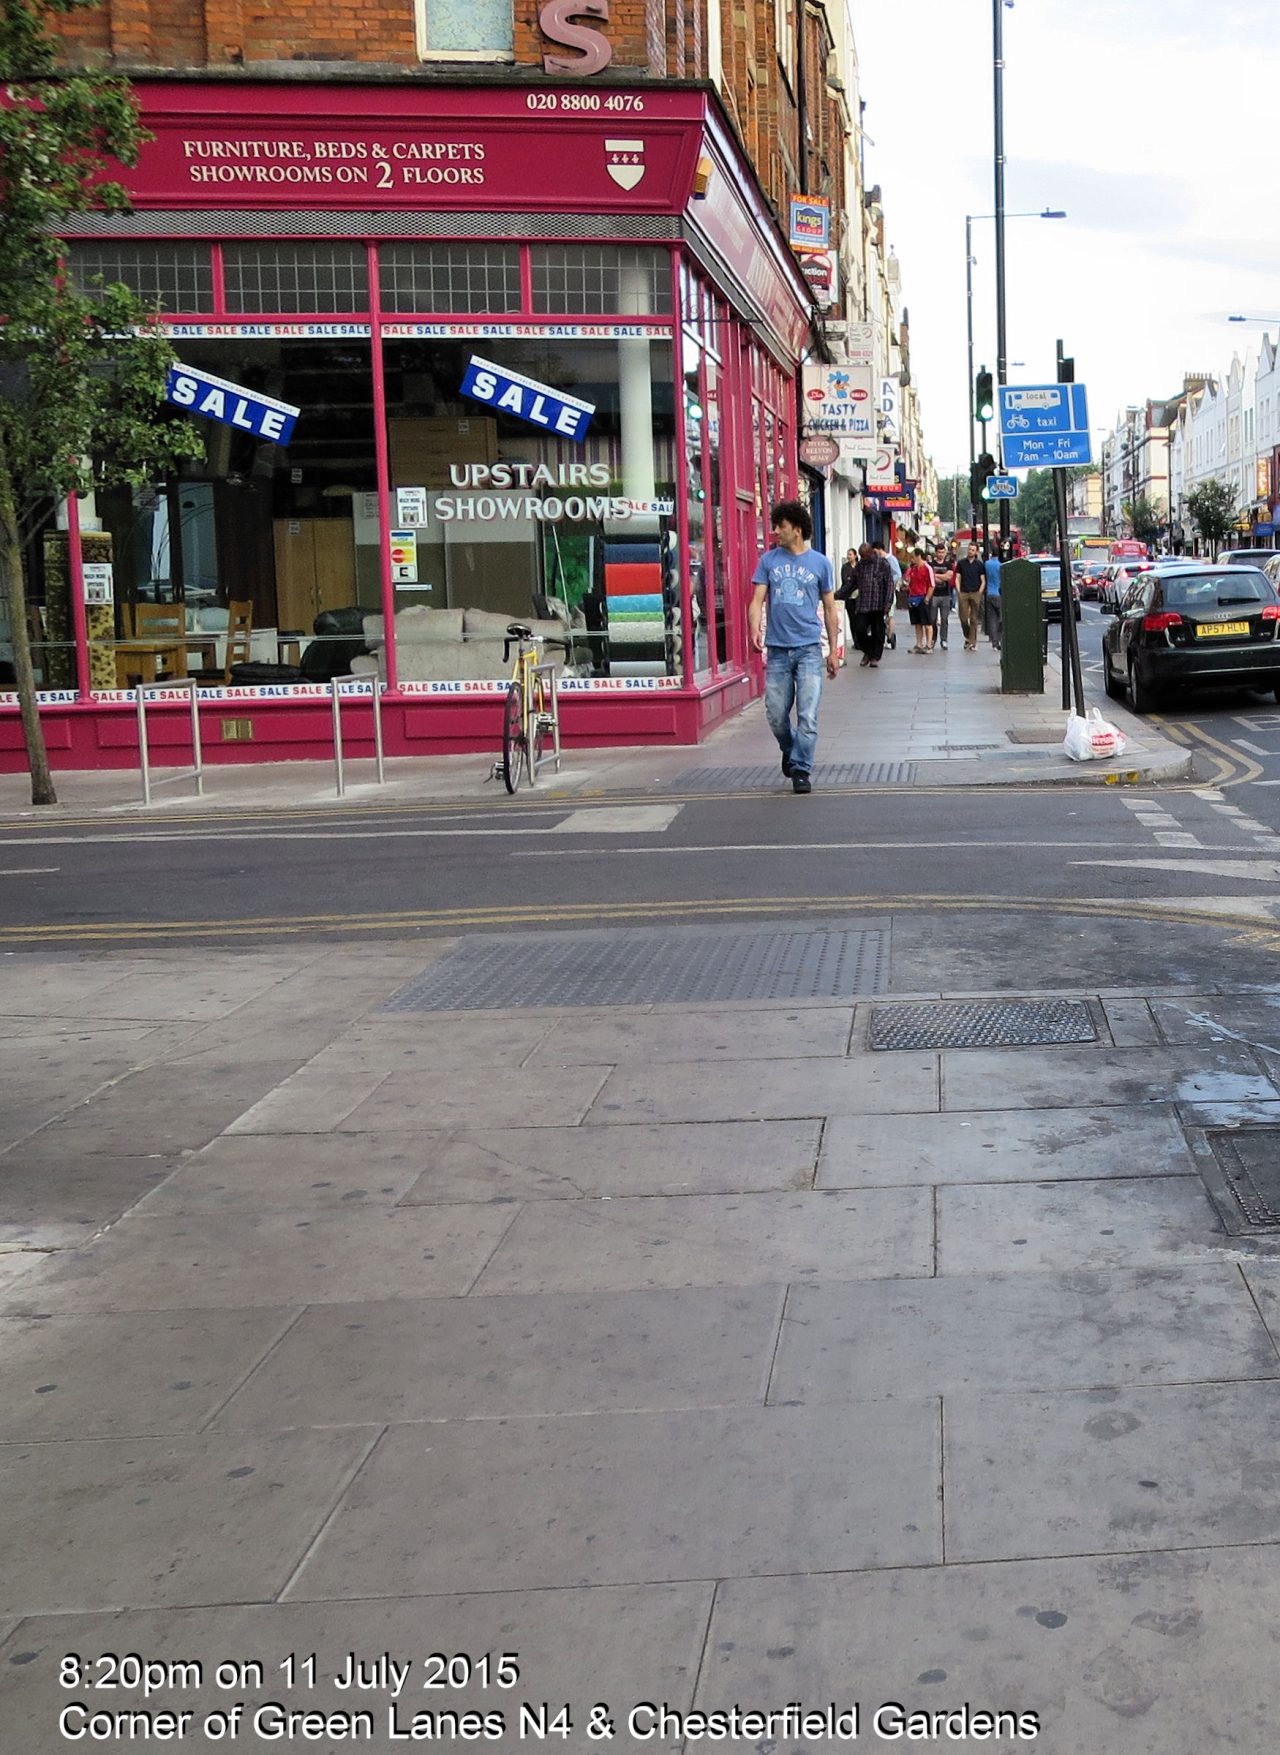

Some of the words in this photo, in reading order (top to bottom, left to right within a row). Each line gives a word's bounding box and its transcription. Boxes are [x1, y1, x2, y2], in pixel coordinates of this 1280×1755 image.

[526, 93, 557, 110] 020
[560, 93, 600, 111] 8800
[604, 94, 644, 112] 4076
[183, 140, 312, 161] FURNITURE,
[315, 141, 367, 159] BEDS
[371, 144, 390, 159] &
[392, 142, 485, 160] CARPETS
[190, 165, 333, 183] SHOWROOMS
[336, 166, 368, 183] ON
[375, 161, 394, 189] 2
[402, 166, 485, 184] FLOORS
[173, 325, 203, 335] SALE
[207, 325, 237, 335] SALE
[240, 325, 271, 335] SALE
[274, 325, 304, 335] SALE
[308, 325, 338, 335] SALE
[341, 325, 371, 335] SALE
[383, 326, 414, 335] SALE
[416, 326, 446, 335] SALE
[449, 326, 479, 335] SALE
[482, 326, 512, 335] SALE
[516, 326, 545, 335] SALE
[548, 327, 577, 336] SALE
[581, 327, 610, 336] SALE
[613, 327, 643, 336] SALE
[1026, 392, 1047, 400] local
[172, 376, 287, 440] SALE
[471, 371, 582, 436] SALE
[821, 403, 857, 416] TASTY
[849, 418, 869, 431] PIZZA
[1036, 416, 1057, 426] taxi
[1022, 440, 1044, 450] Mon
[1058, 438, 1071, 448] Fri
[1017, 452, 1039, 462] 7am
[1053, 450, 1079, 460] 10am
[450, 463, 611, 488] UPSTAIRS
[435, 496, 634, 522] SHOWROOMS
[1201, 625, 1225, 635] AP57
[400, 683, 429, 693] SALE
[431, 682, 461, 692] SALE
[464, 681, 493, 691] SALE
[562, 679, 591, 689] SALE
[594, 679, 622, 689] SALE
[625, 678, 654, 688] SALE
[93, 692, 123, 701] SALE
[160, 690, 190, 700] SALE
[226, 688, 256, 698] SALE
[259, 687, 289, 696] SALE
[292, 686, 322, 696] SALE
